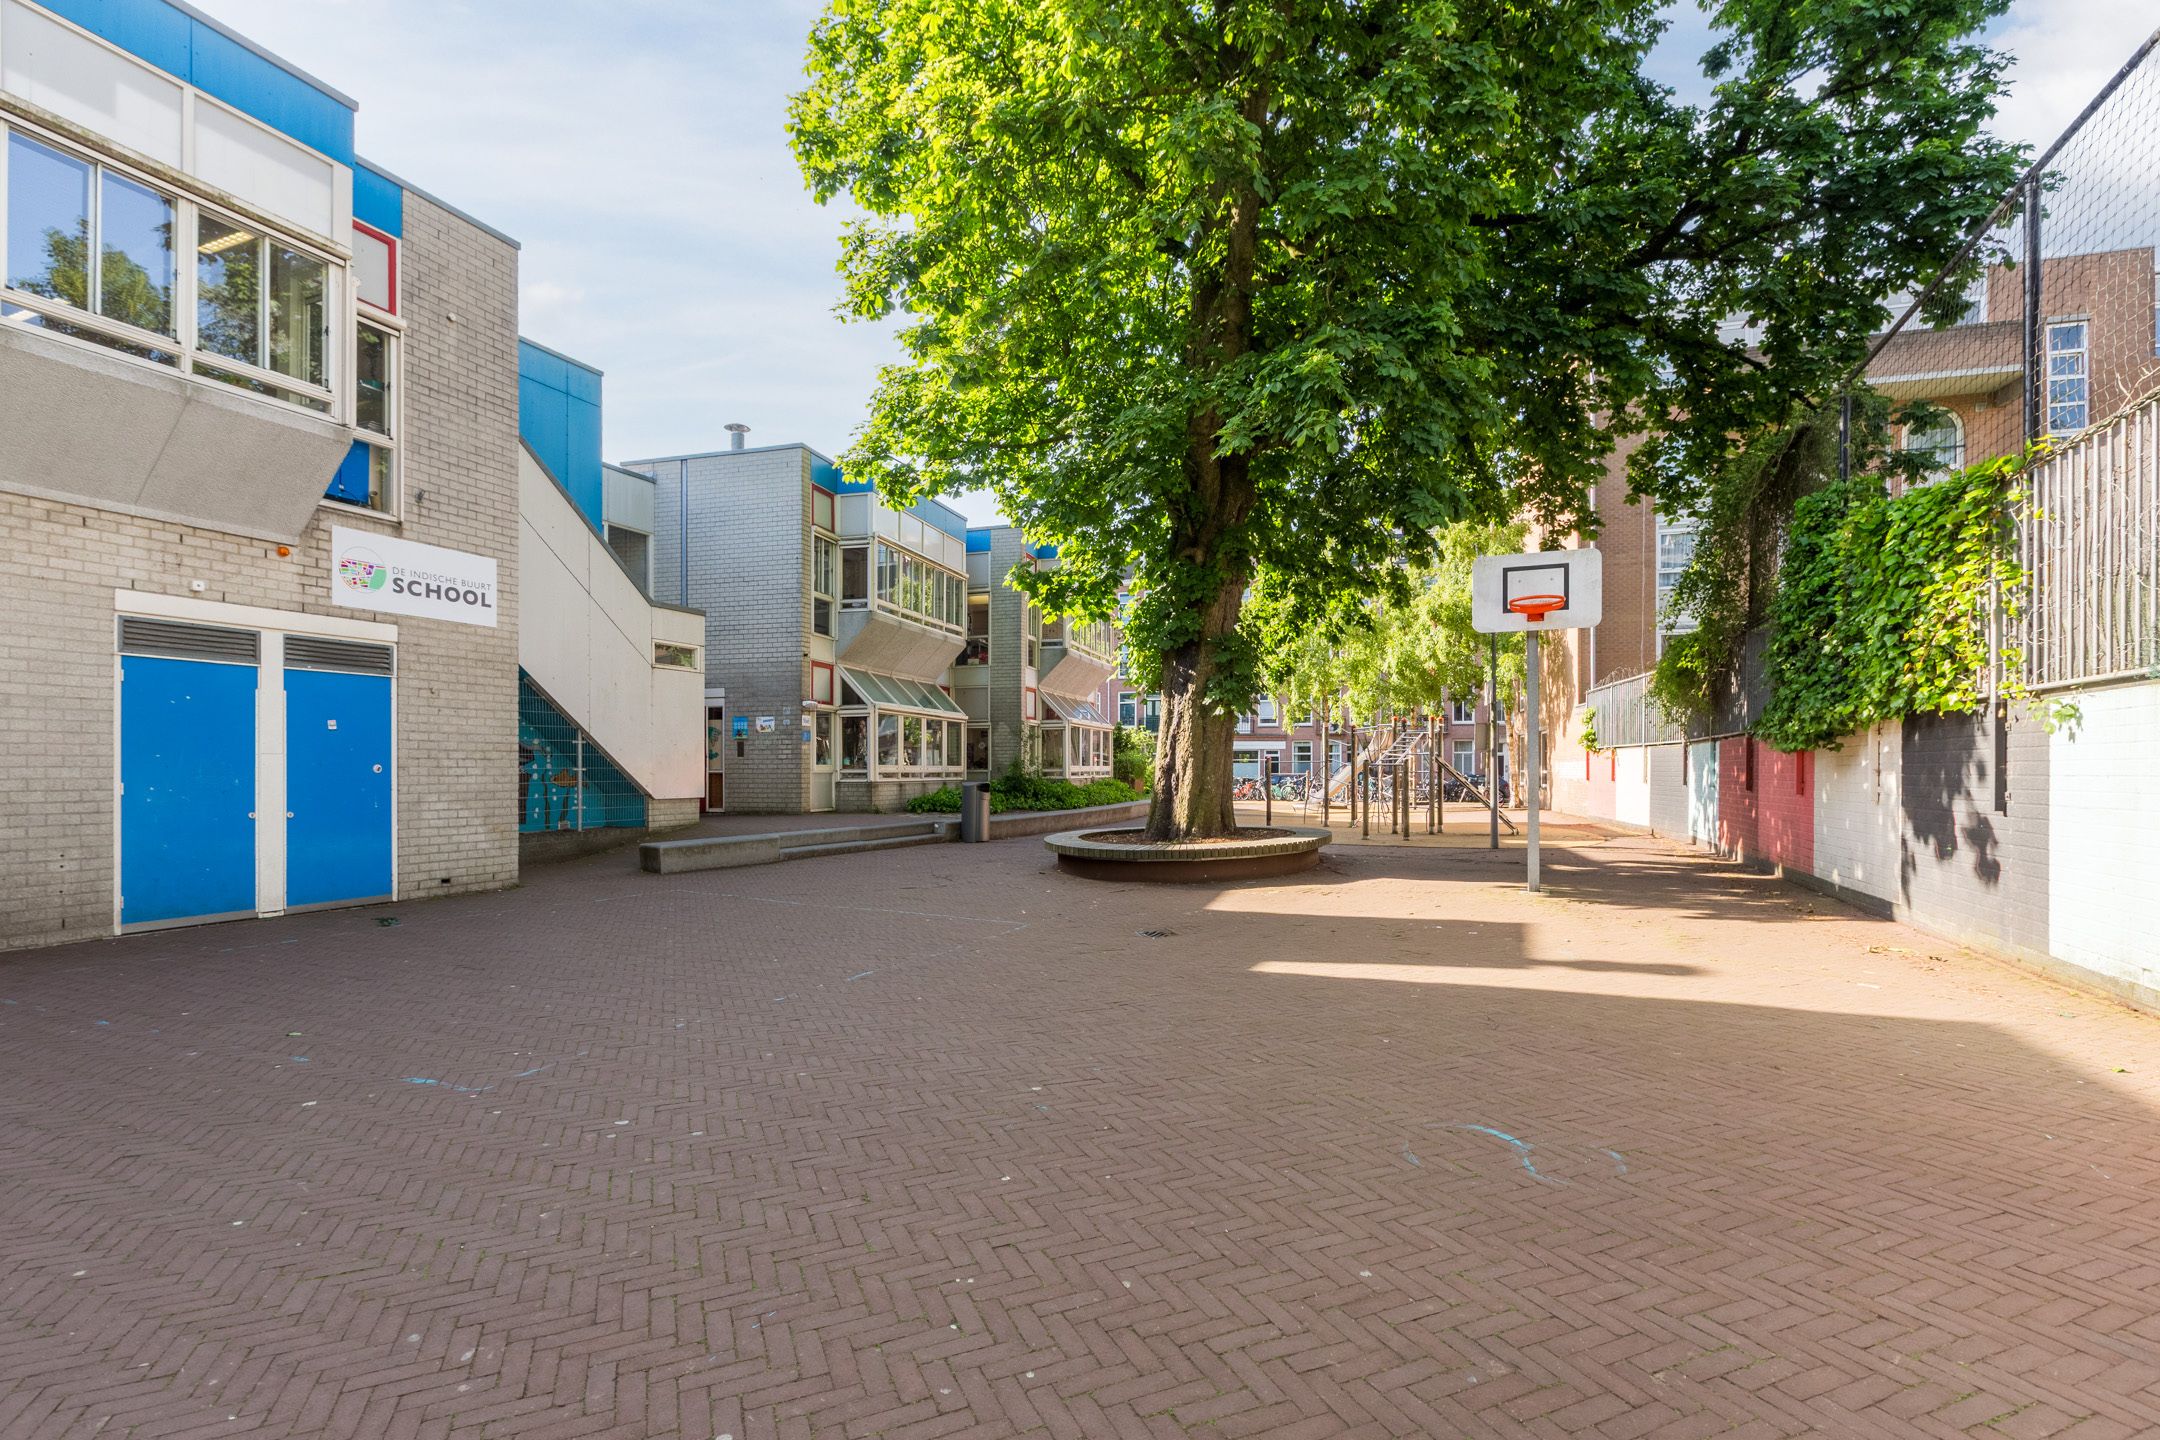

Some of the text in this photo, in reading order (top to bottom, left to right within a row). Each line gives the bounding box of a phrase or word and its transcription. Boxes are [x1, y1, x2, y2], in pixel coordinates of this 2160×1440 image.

[392, 566, 492, 591] DE INDISCHE BUURT
[392, 577, 492, 608] SCHOOL
